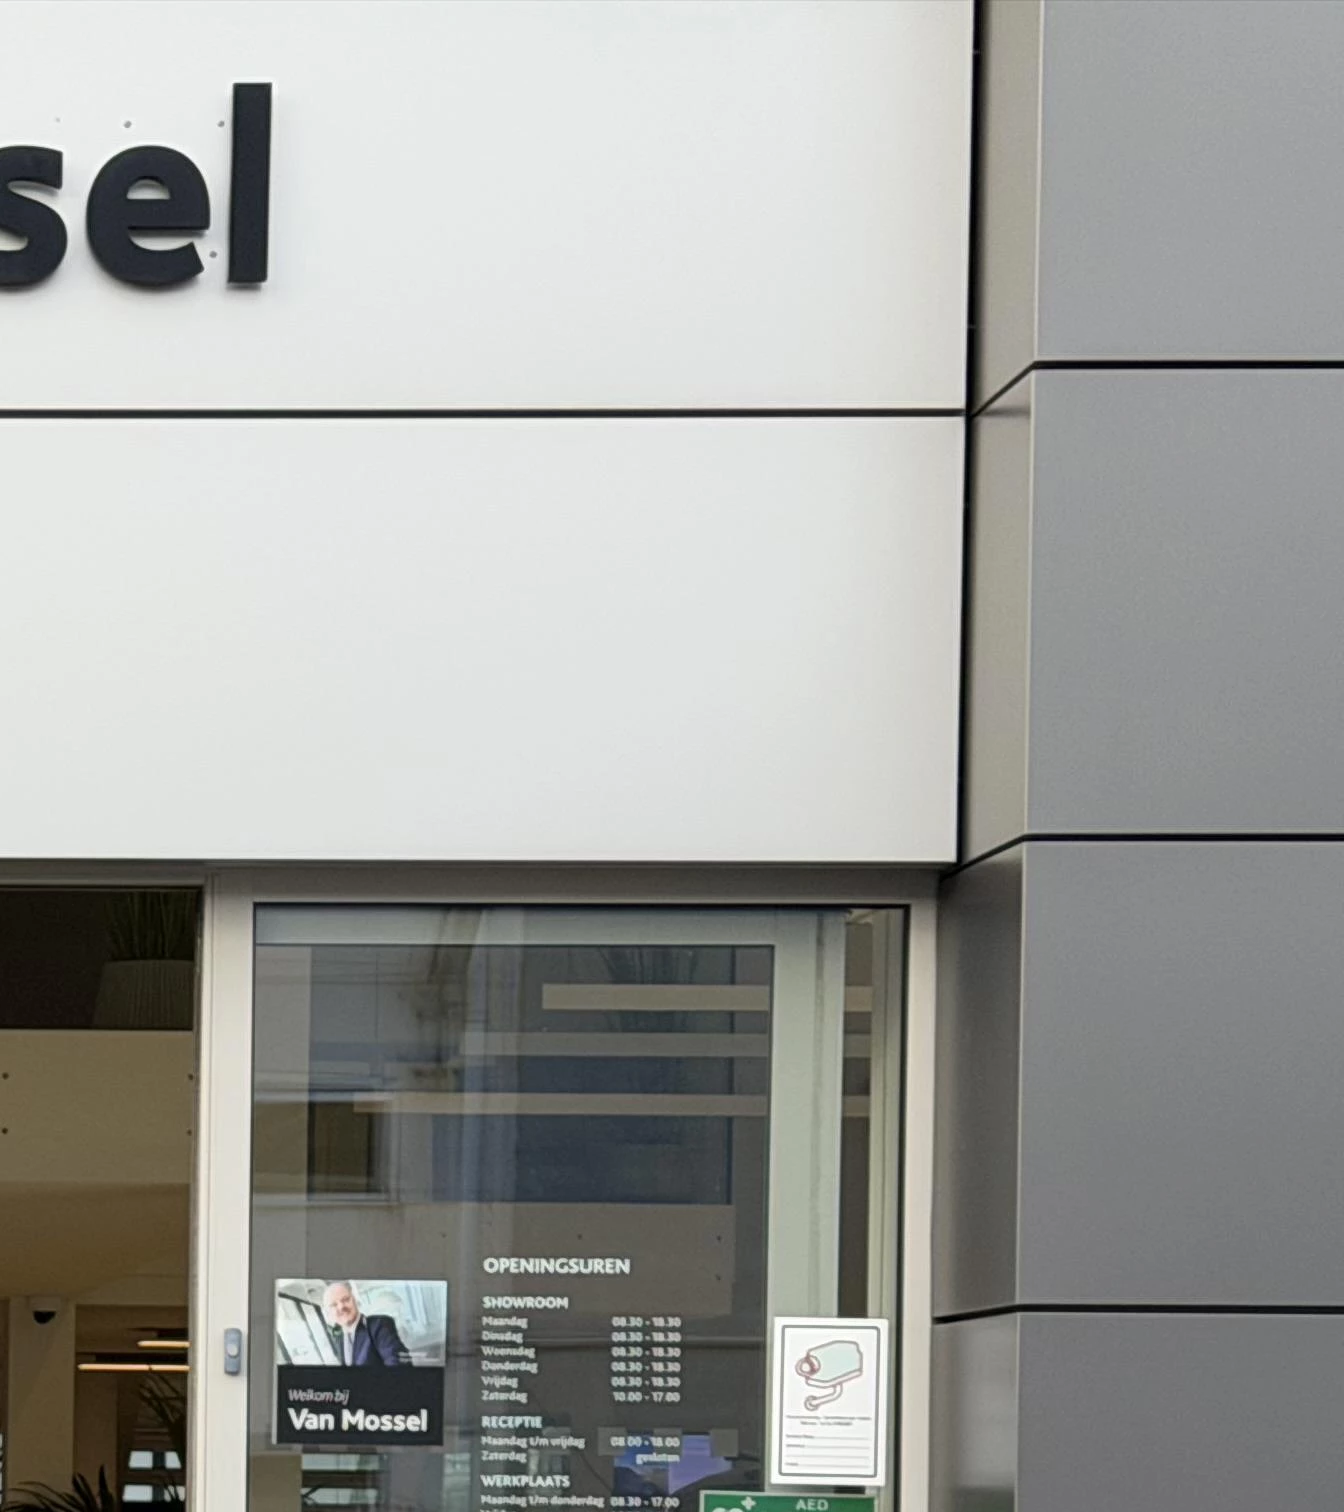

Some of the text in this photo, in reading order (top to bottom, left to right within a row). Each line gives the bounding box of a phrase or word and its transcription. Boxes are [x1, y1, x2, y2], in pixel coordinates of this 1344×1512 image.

[483, 1257, 630, 1274] OPENINGSUREN
[482, 1296, 568, 1309] SHOWROOM
[481, 1316, 528, 1329] Maandag
[481, 1331, 523, 1343] Dinsdag
[480, 1346, 536, 1358] Woensdag
[480, 1361, 538, 1374] Donderdag
[480, 1376, 518, 1388] Vrijdag
[288, 1388, 350, 1406] Welkom bij
[480, 1391, 528, 1404] Zaterdag
[287, 1408, 428, 1432] Van Mossel
[481, 1415, 543, 1428] RECEPTIE
[481, 1436, 528, 1449] Maandag
[481, 1451, 527, 1463] Zaterdag
[480, 1474, 571, 1488] WERKPLAATS
[480, 1495, 527, 1508] Maandag
[795, 1499, 829, 1511] AED
